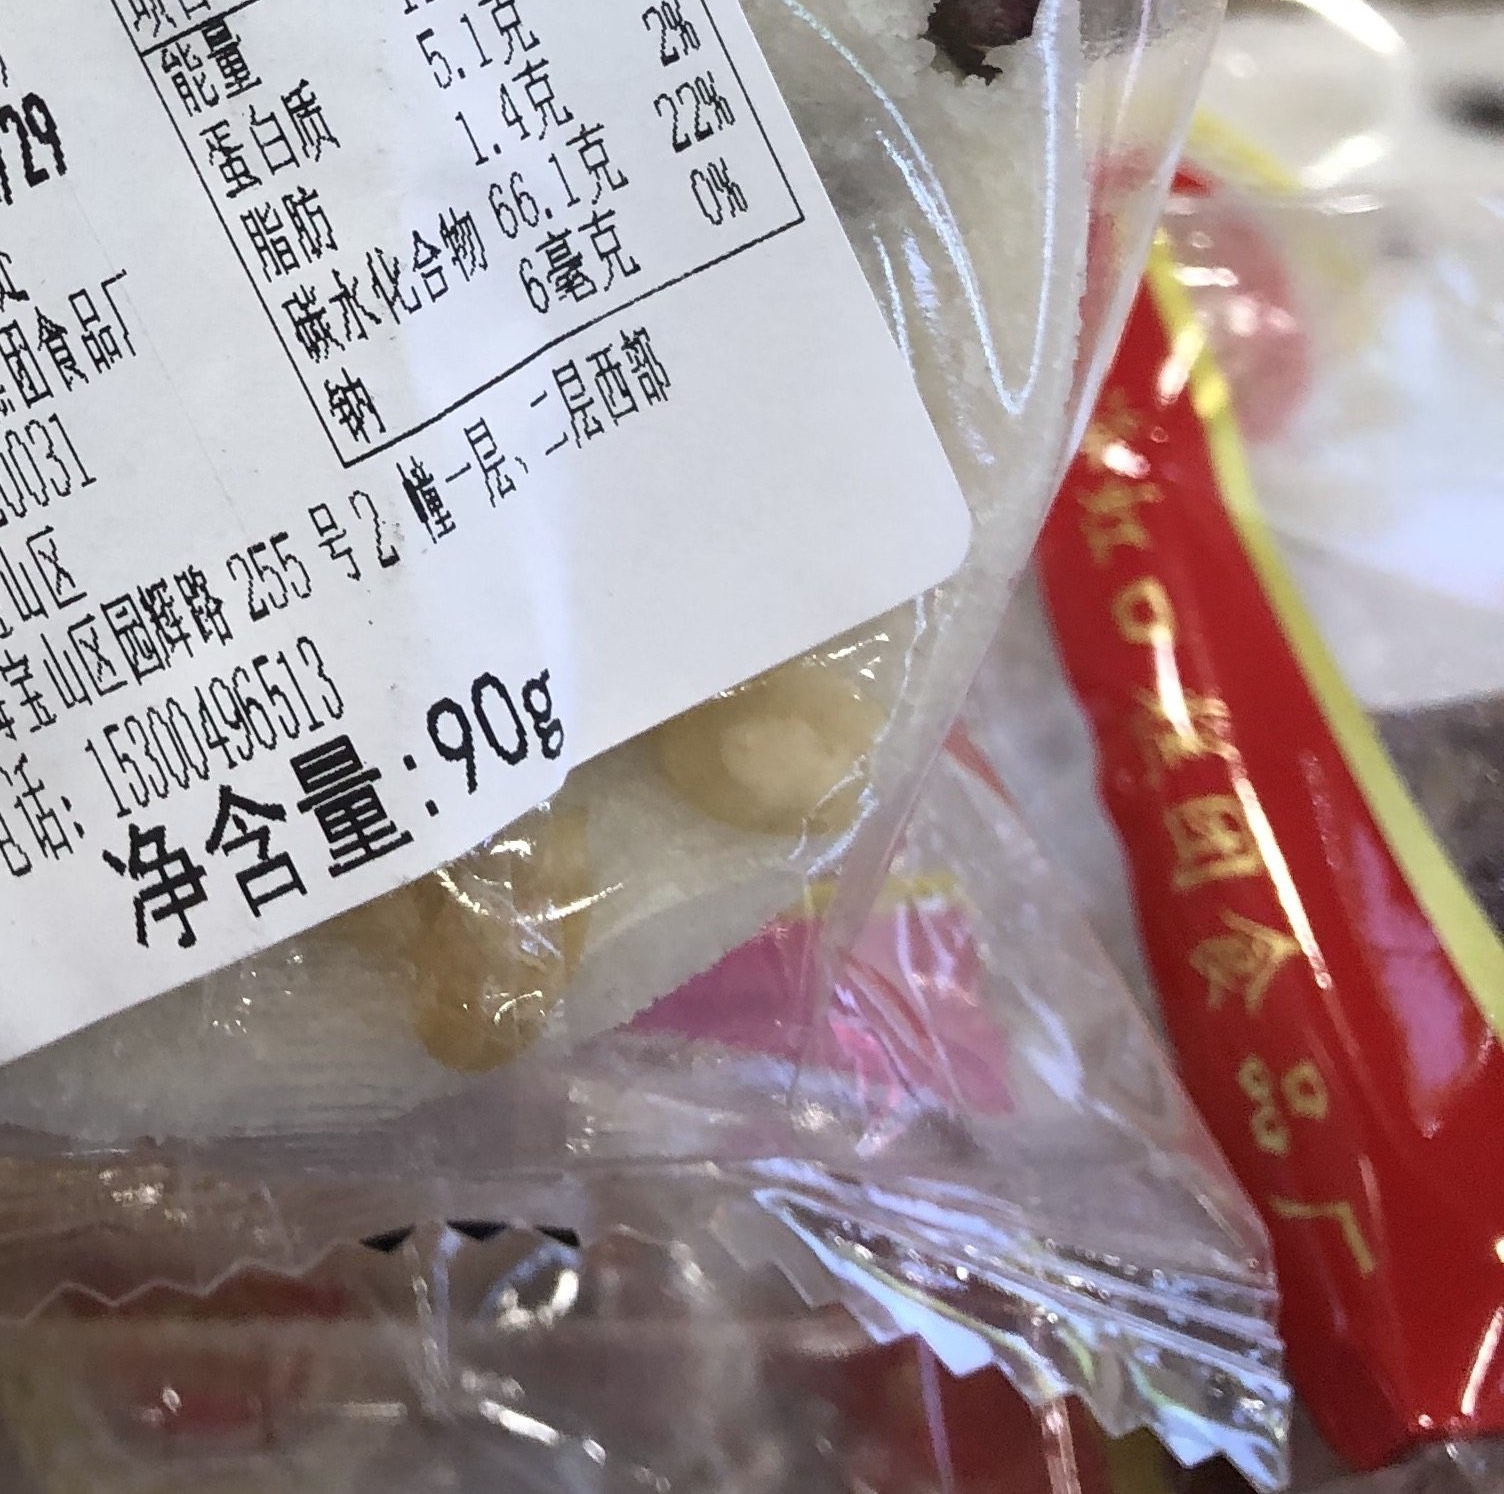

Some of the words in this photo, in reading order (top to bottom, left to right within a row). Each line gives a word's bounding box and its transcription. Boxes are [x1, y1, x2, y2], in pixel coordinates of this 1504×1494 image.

[158, 14, 264, 119] 能量
[197, 76, 342, 201] 蛋白质
[237, 183, 340, 284] 脂肪
[452, 55, 576, 168] 1.4克
[279, 205, 490, 365] 碳水化合物
[485, 120, 631, 241] 66.1克
[650, 68, 737, 155] 22%
[321, 364, 388, 445] 钠
[516, 206, 643, 316] 6毫克
[687, 154, 750, 227] 0%
[99, 666, 566, 951] 净含量:90g
